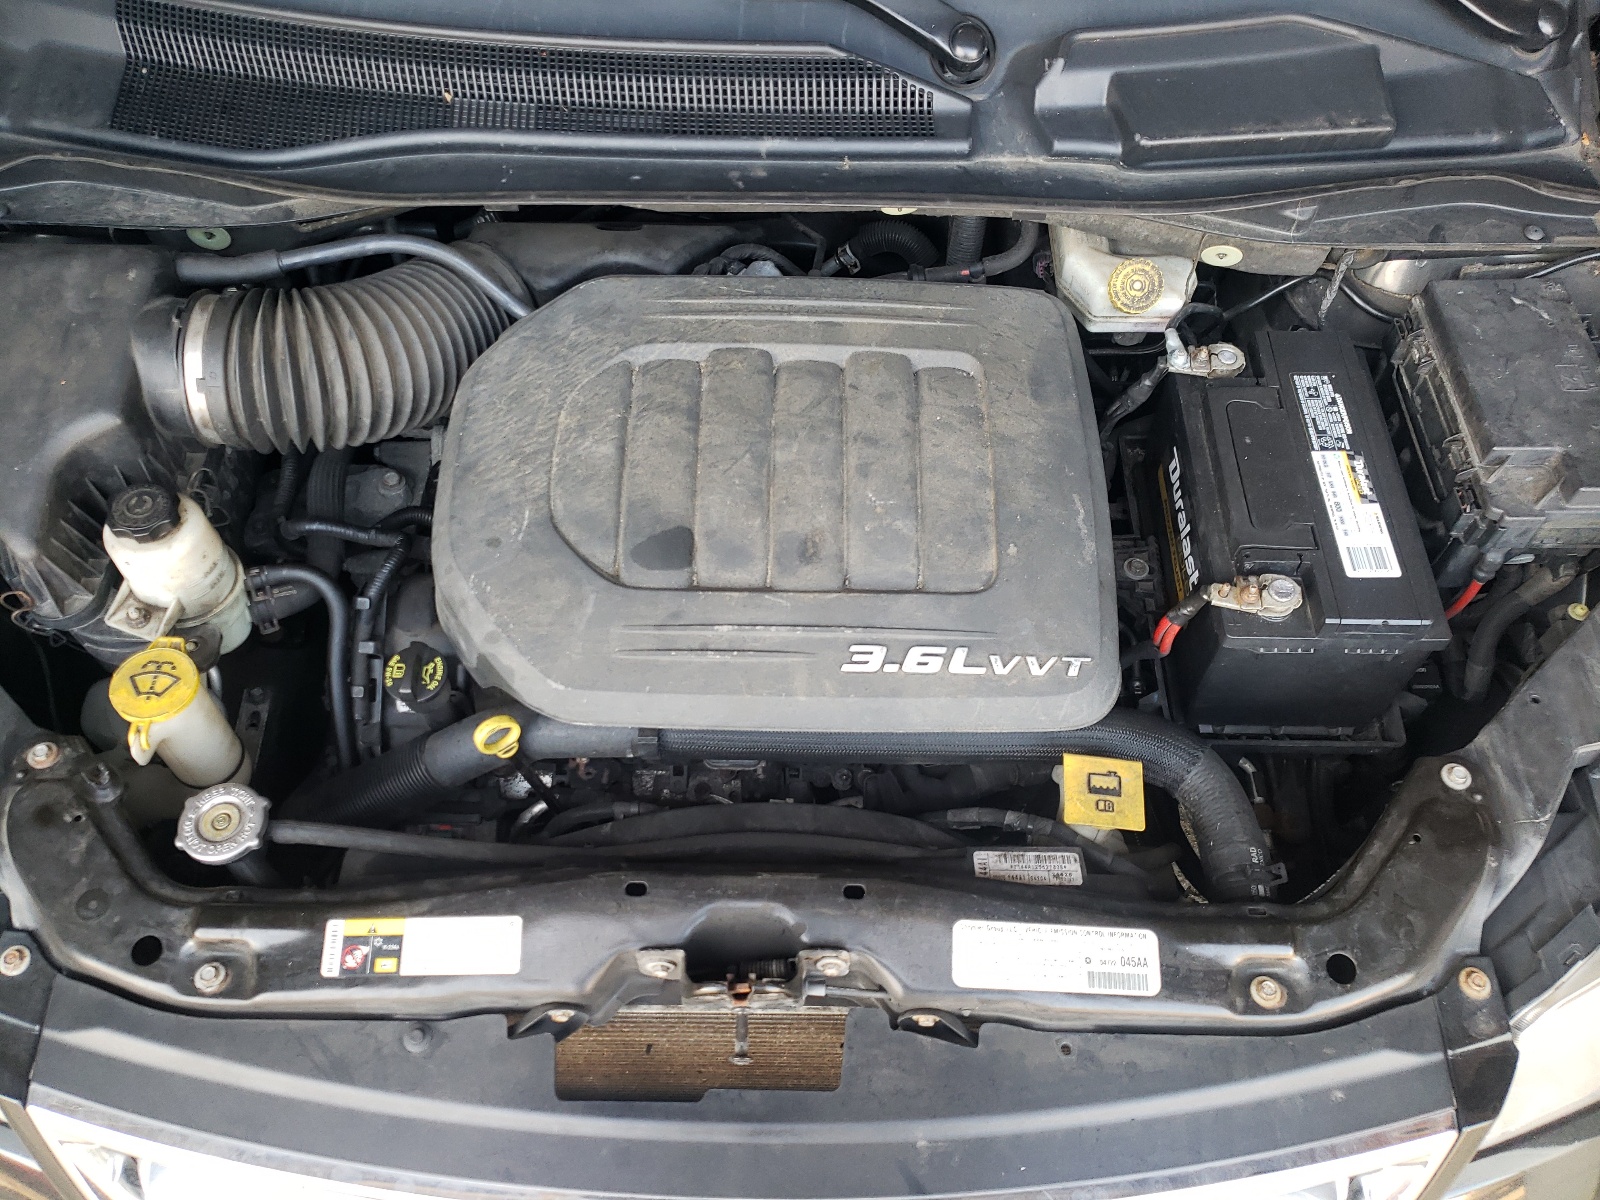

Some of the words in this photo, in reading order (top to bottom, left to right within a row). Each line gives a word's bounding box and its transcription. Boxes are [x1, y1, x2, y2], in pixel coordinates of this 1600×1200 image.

[1168, 445, 1200, 592] Duralast
[433, 656, 444, 681] ENGINE
[840, 643, 987, 676] 3.6L
[988, 654, 1092, 678] VVT
[425, 680, 439, 691] OIL
[1249, 846, 1259, 863] RAD
[1120, 955, 1149, 969] 045AA
